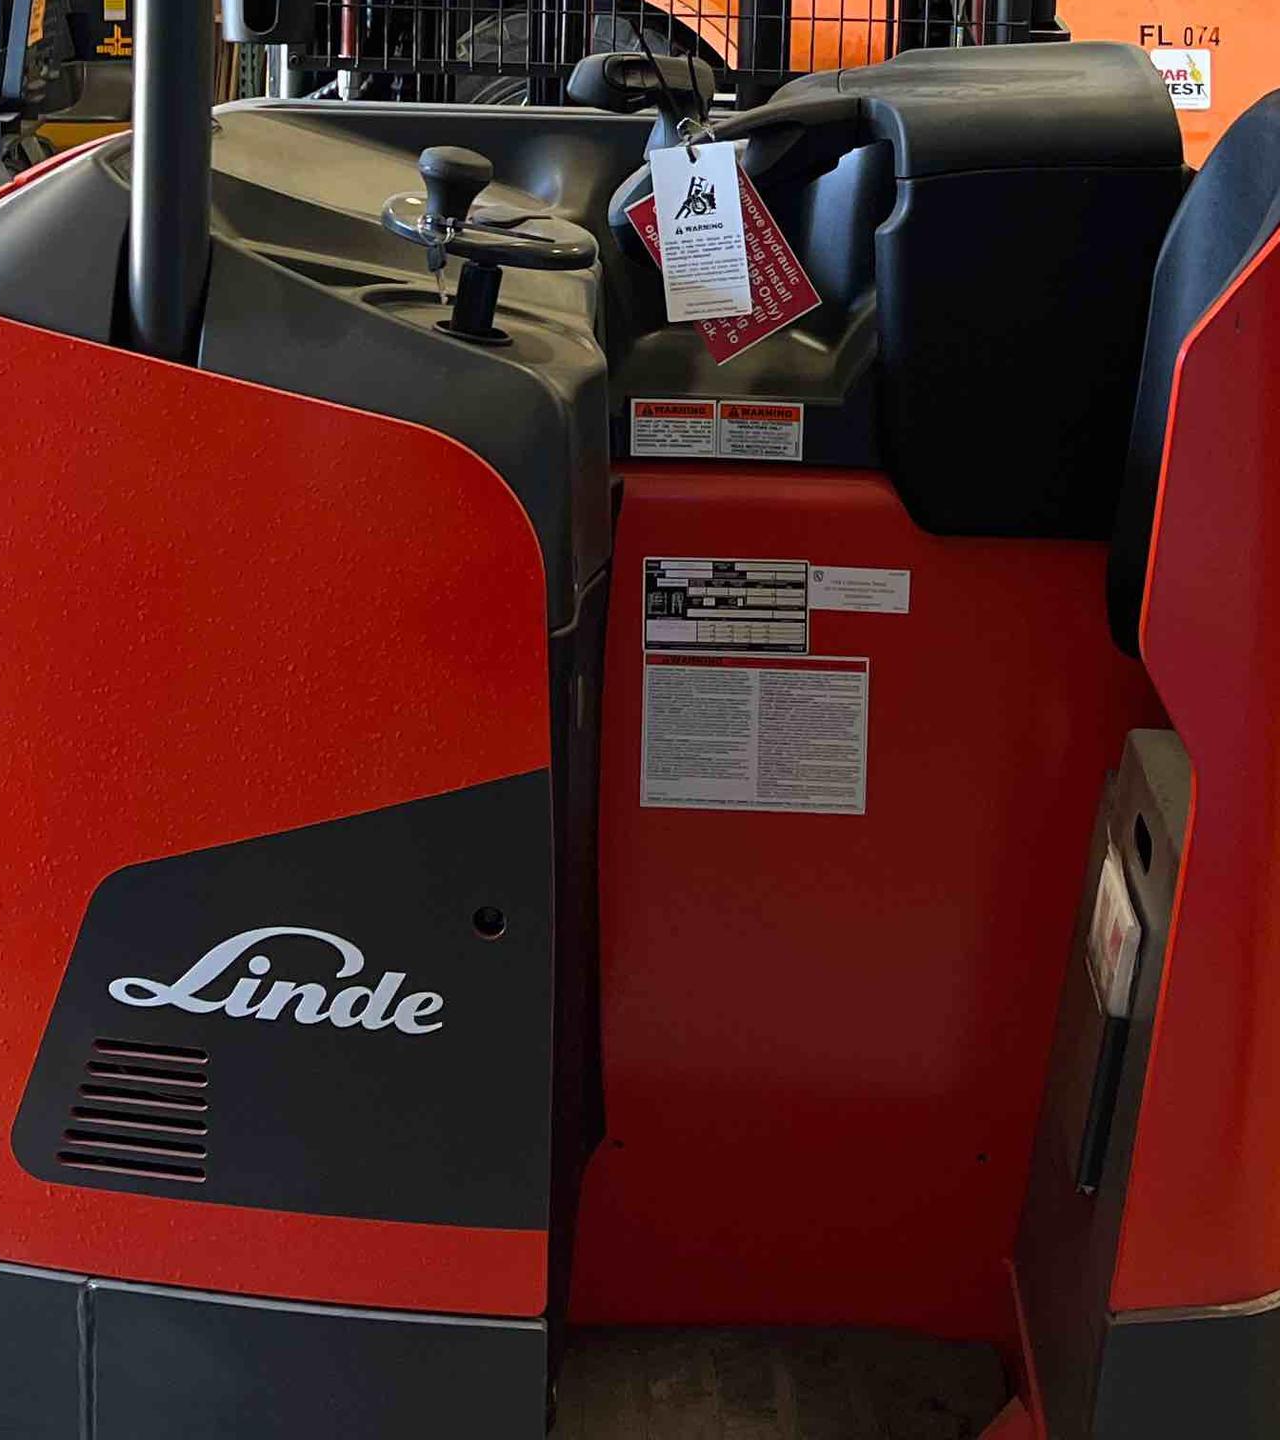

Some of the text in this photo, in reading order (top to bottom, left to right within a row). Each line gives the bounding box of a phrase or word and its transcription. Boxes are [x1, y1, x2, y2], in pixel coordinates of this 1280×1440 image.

[1140, 25, 1220, 46] FL 074
[685, 222, 724, 233] WARNING
[761, 226, 799, 287] hydraulic
[764, 263, 793, 303] Install
[757, 286, 784, 322] Only)
[108, 926, 443, 1037] Linde
